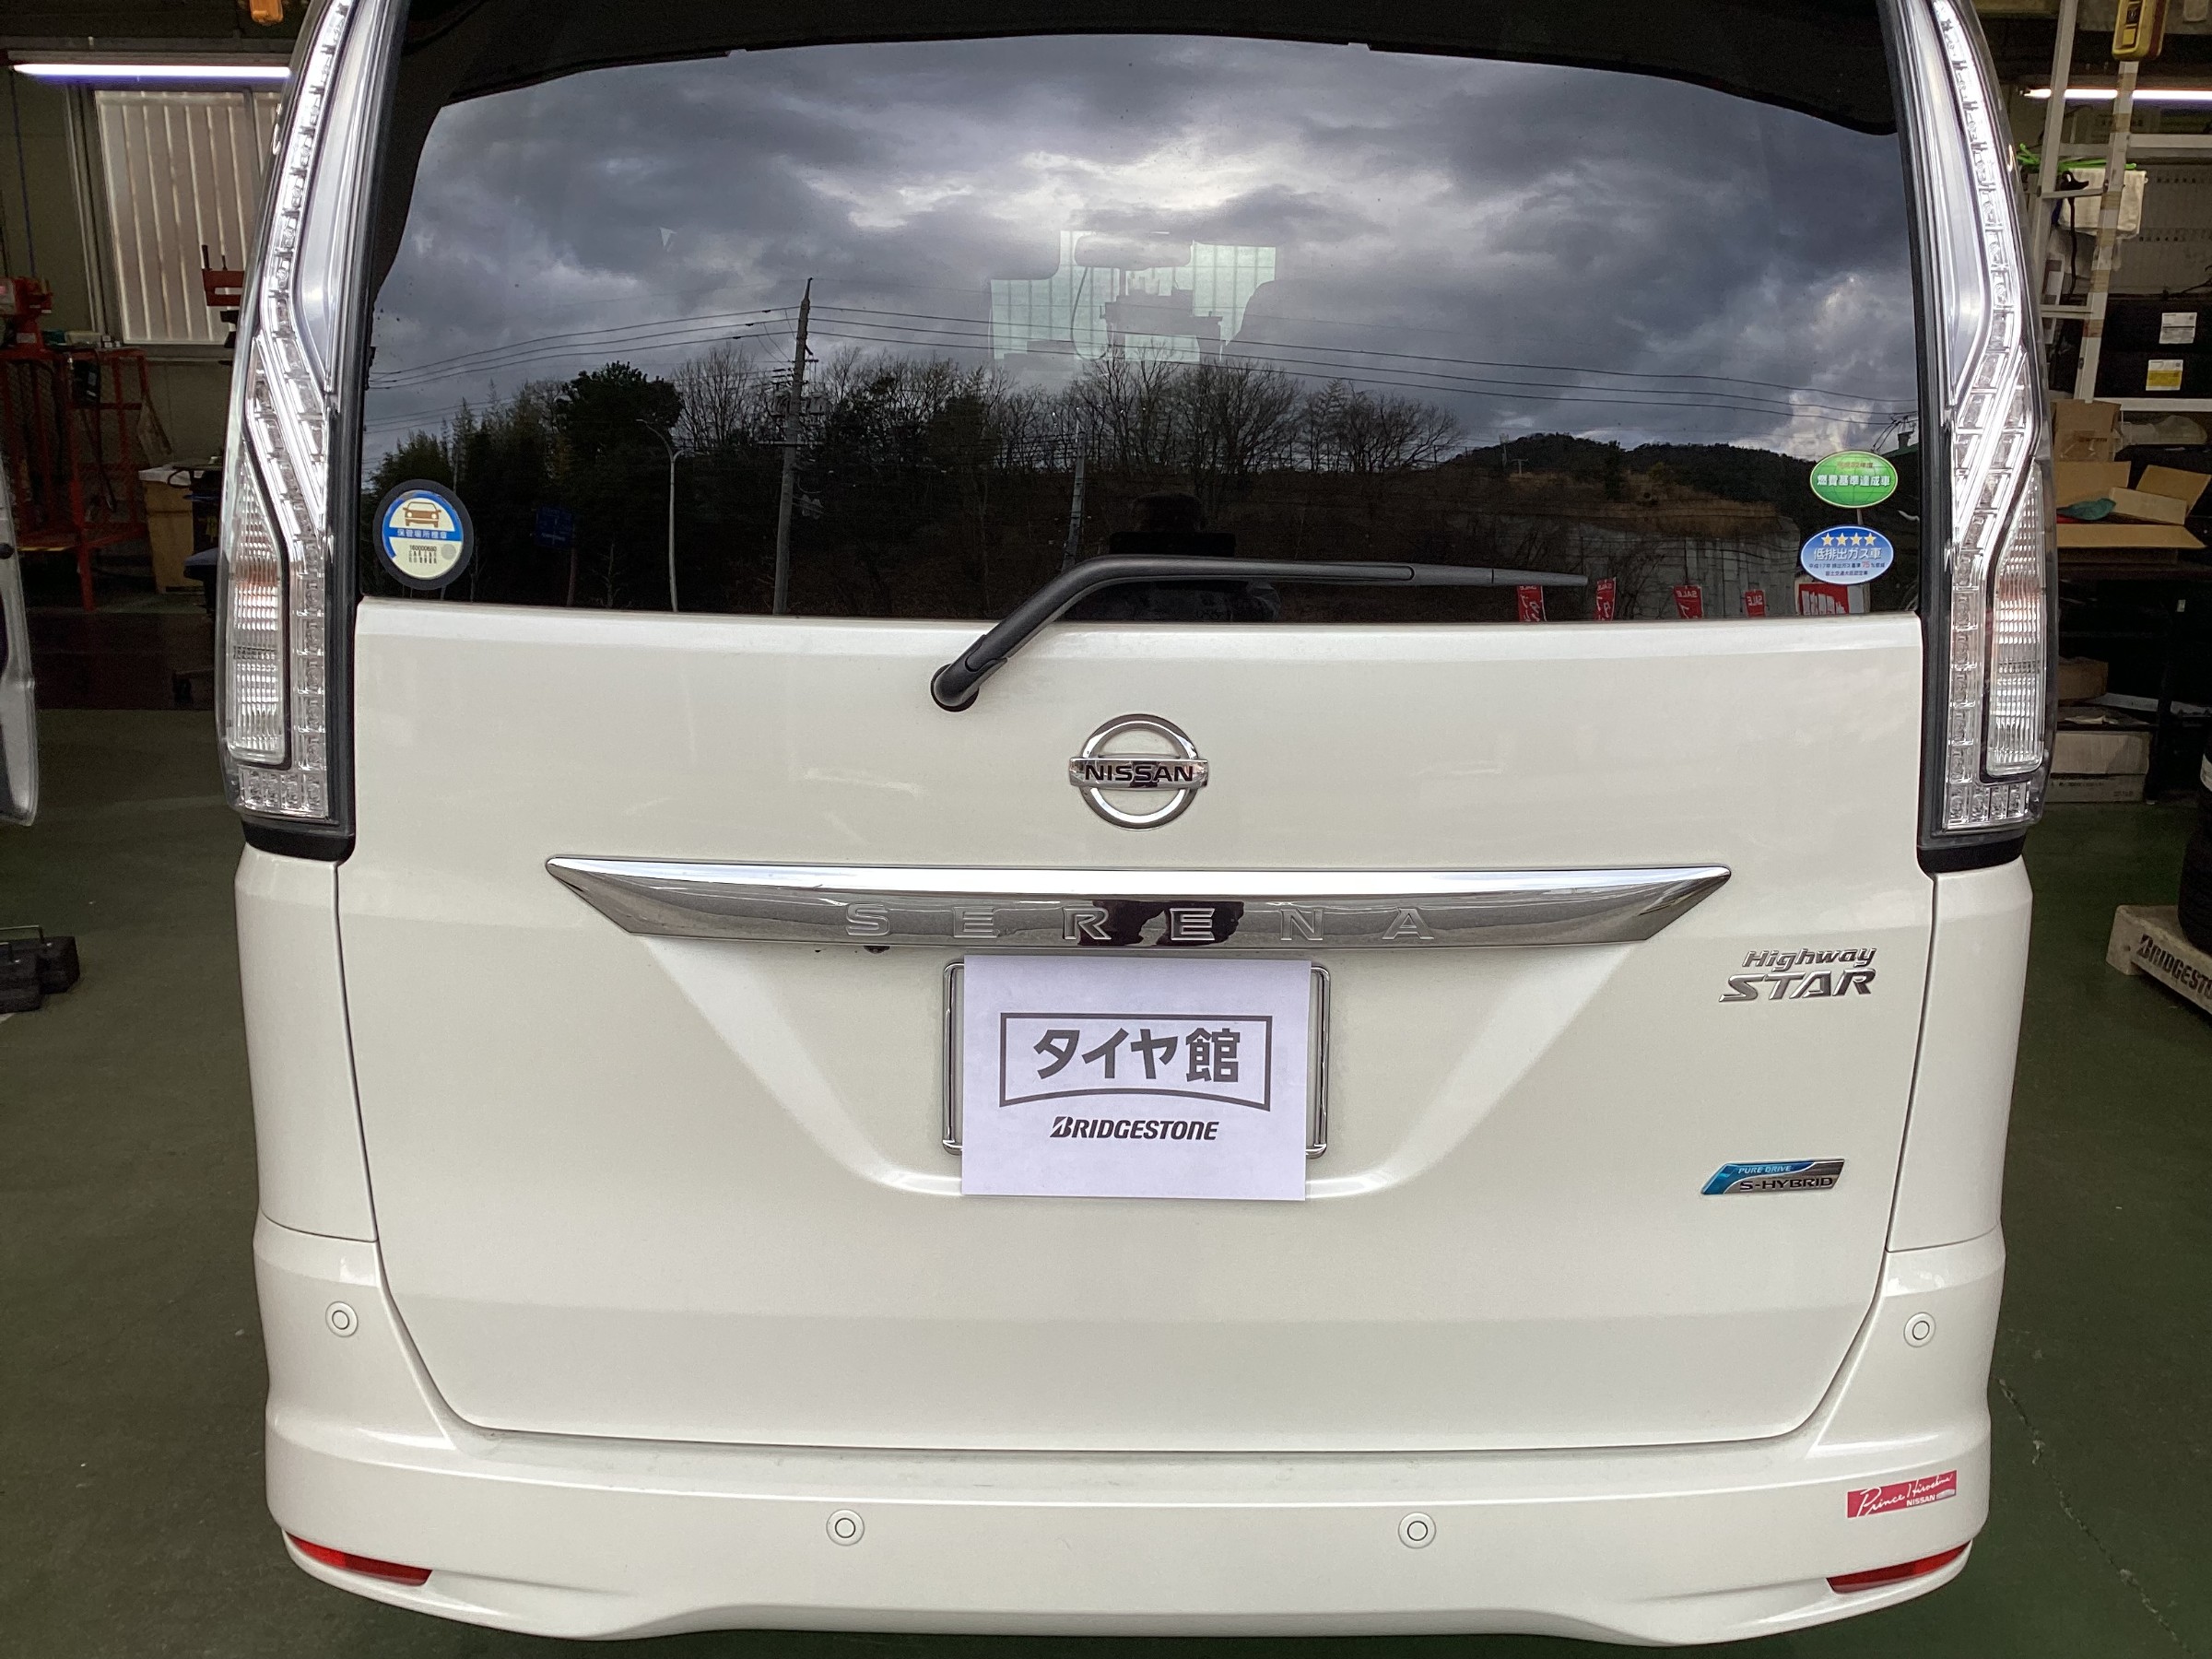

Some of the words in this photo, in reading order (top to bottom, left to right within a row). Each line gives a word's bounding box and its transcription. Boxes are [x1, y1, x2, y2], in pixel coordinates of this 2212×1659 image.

[1813, 547, 1882, 561] 低排出ガス車
[1084, 764, 1194, 782] NISSAN
[844, 902, 1435, 942] SERENA
[1742, 947, 1877, 972] Highway
[1719, 968, 1877, 1003] STAR
[1033, 1027, 1241, 1083] タイヤ館
[1049, 1115, 1220, 1141] BRIDGESTONE
[1737, 1166, 1763, 1174] PURE
[1764, 1165, 1792, 1173] DRIVE
[1739, 1177, 1833, 1192] S-HYBRID
[1856, 1486, 1905, 1517] Prince
[1906, 1494, 1936, 1507] NISSAN
